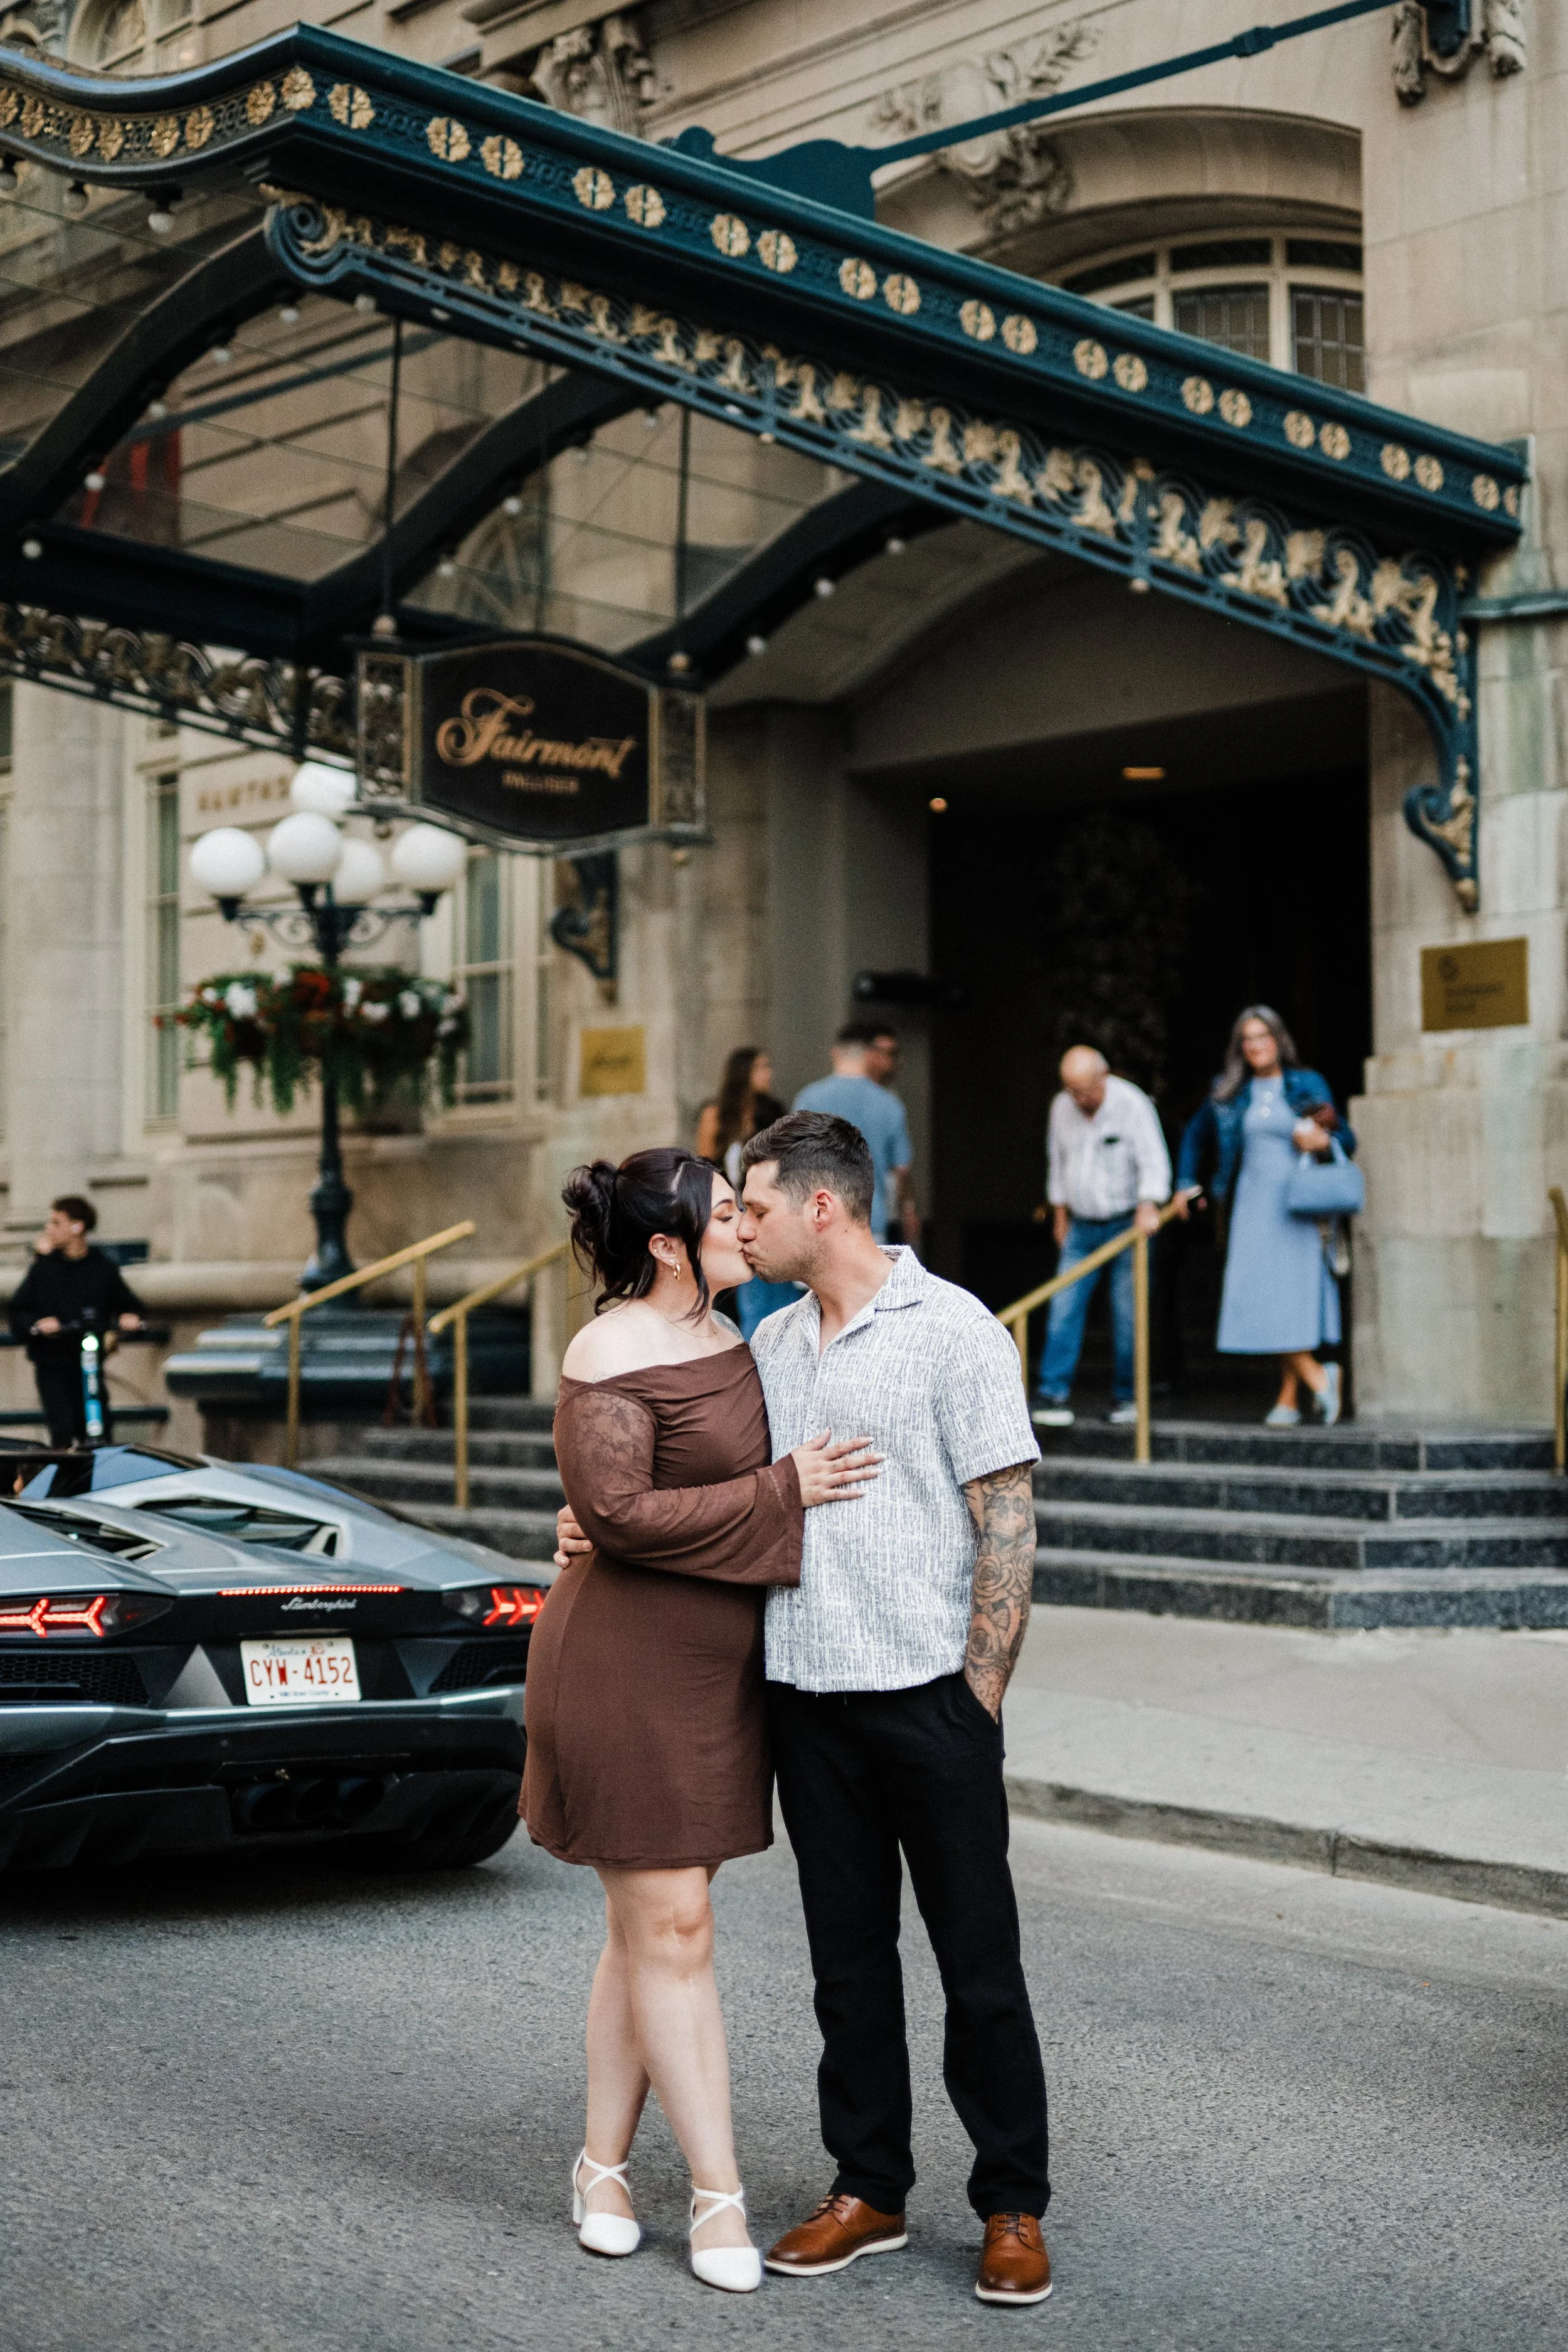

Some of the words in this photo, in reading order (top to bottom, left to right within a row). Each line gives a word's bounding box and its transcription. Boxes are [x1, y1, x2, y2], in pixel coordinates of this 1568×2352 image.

[435, 687, 638, 780] Fairmont
[280, 1596, 357, 1613] Lamborghini
[250, 1656, 353, 1687] CYW-4152
